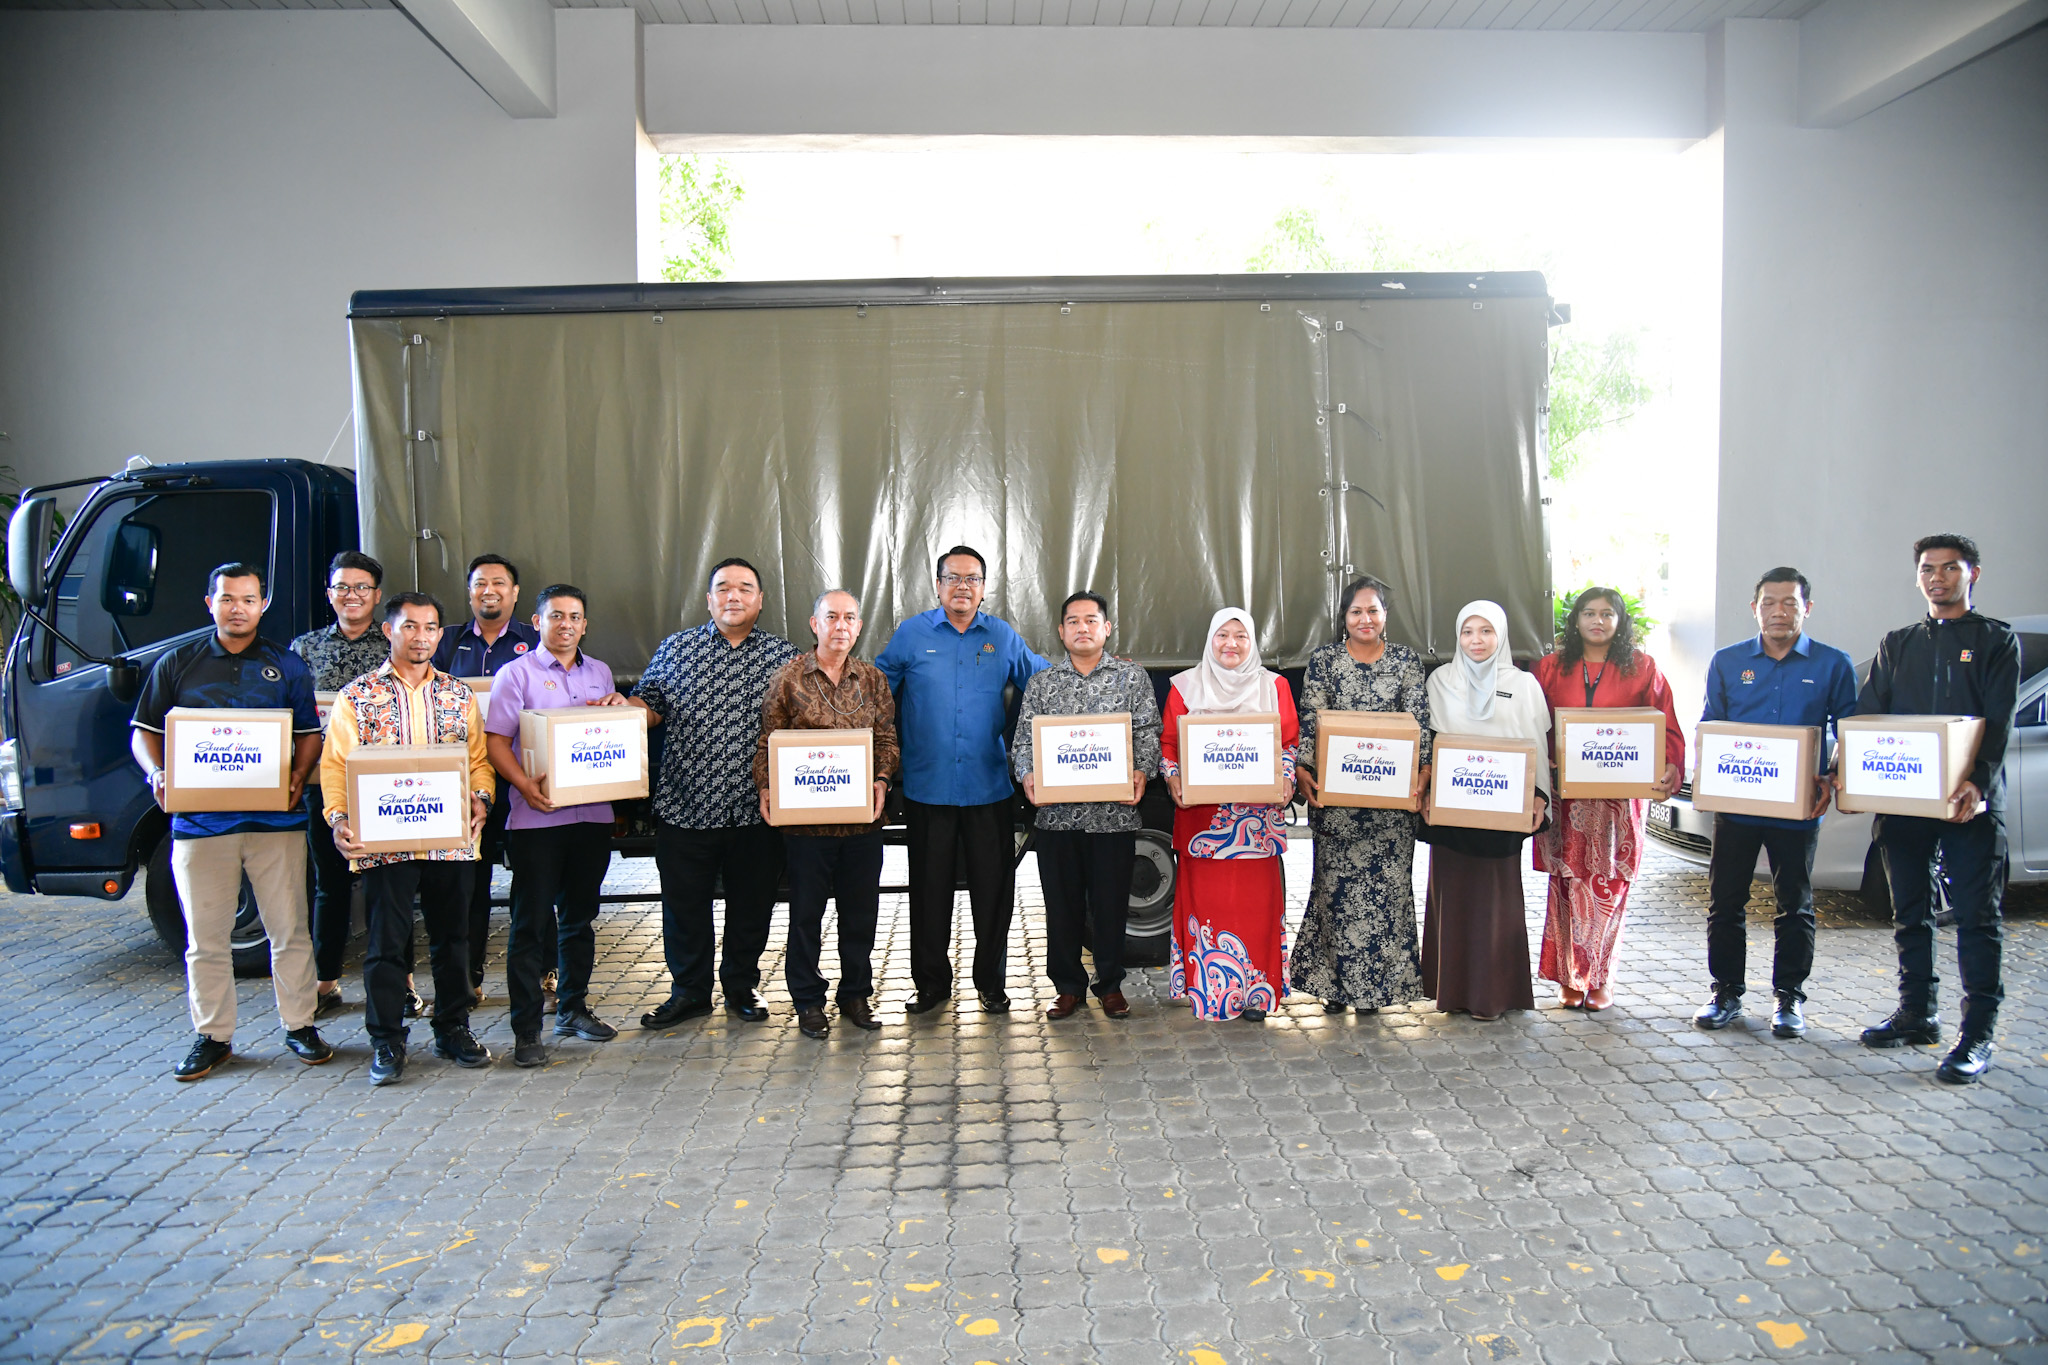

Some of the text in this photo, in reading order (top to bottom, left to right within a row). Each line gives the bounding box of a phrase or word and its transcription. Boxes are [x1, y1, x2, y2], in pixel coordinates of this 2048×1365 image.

[195, 741, 234, 753] Skuad
[572, 741, 603, 753] Skuad
[1058, 743, 1088, 754] Skuad
[1204, 742, 1235, 753] Skuad
[1582, 741, 1615, 751] Skuad
[194, 753, 262, 763] MADANI
[571, 749, 625, 763] MADANI
[1057, 752, 1112, 764] MADANI
[1203, 752, 1259, 763] MADANI
[1343, 753, 1374, 764] Skuad
[1581, 751, 1639, 761] MADANI
[1719, 753, 1753, 764] Skuad
[1863, 749, 1897, 761] Skuad
[212, 764, 244, 772] @KDN
[586, 761, 612, 770] @KDN
[795, 765, 827, 776] Skuad
[1072, 763, 1098, 771] @KDN
[1217, 763, 1244, 771] @KDN
[1341, 763, 1396, 776] MADANI
[1718, 764, 1778, 778] MADANI
[1862, 760, 1922, 774] MADANI
[1355, 773, 1381, 781] @KDN
[1453, 767, 1485, 777] Skuad
[1878, 772, 1906, 781] @KDN
[794, 774, 850, 785] MADANI
[1452, 777, 1508, 789] MADANI
[1733, 776, 1762, 784] @KDN
[809, 785, 836, 793] @KDN
[1466, 788, 1493, 796] @KDN
[379, 793, 416, 806] Skuad
[378, 803, 443, 816] MADANI
[1650, 802, 1670, 823] 5693
[396, 814, 427, 824] @KDN
